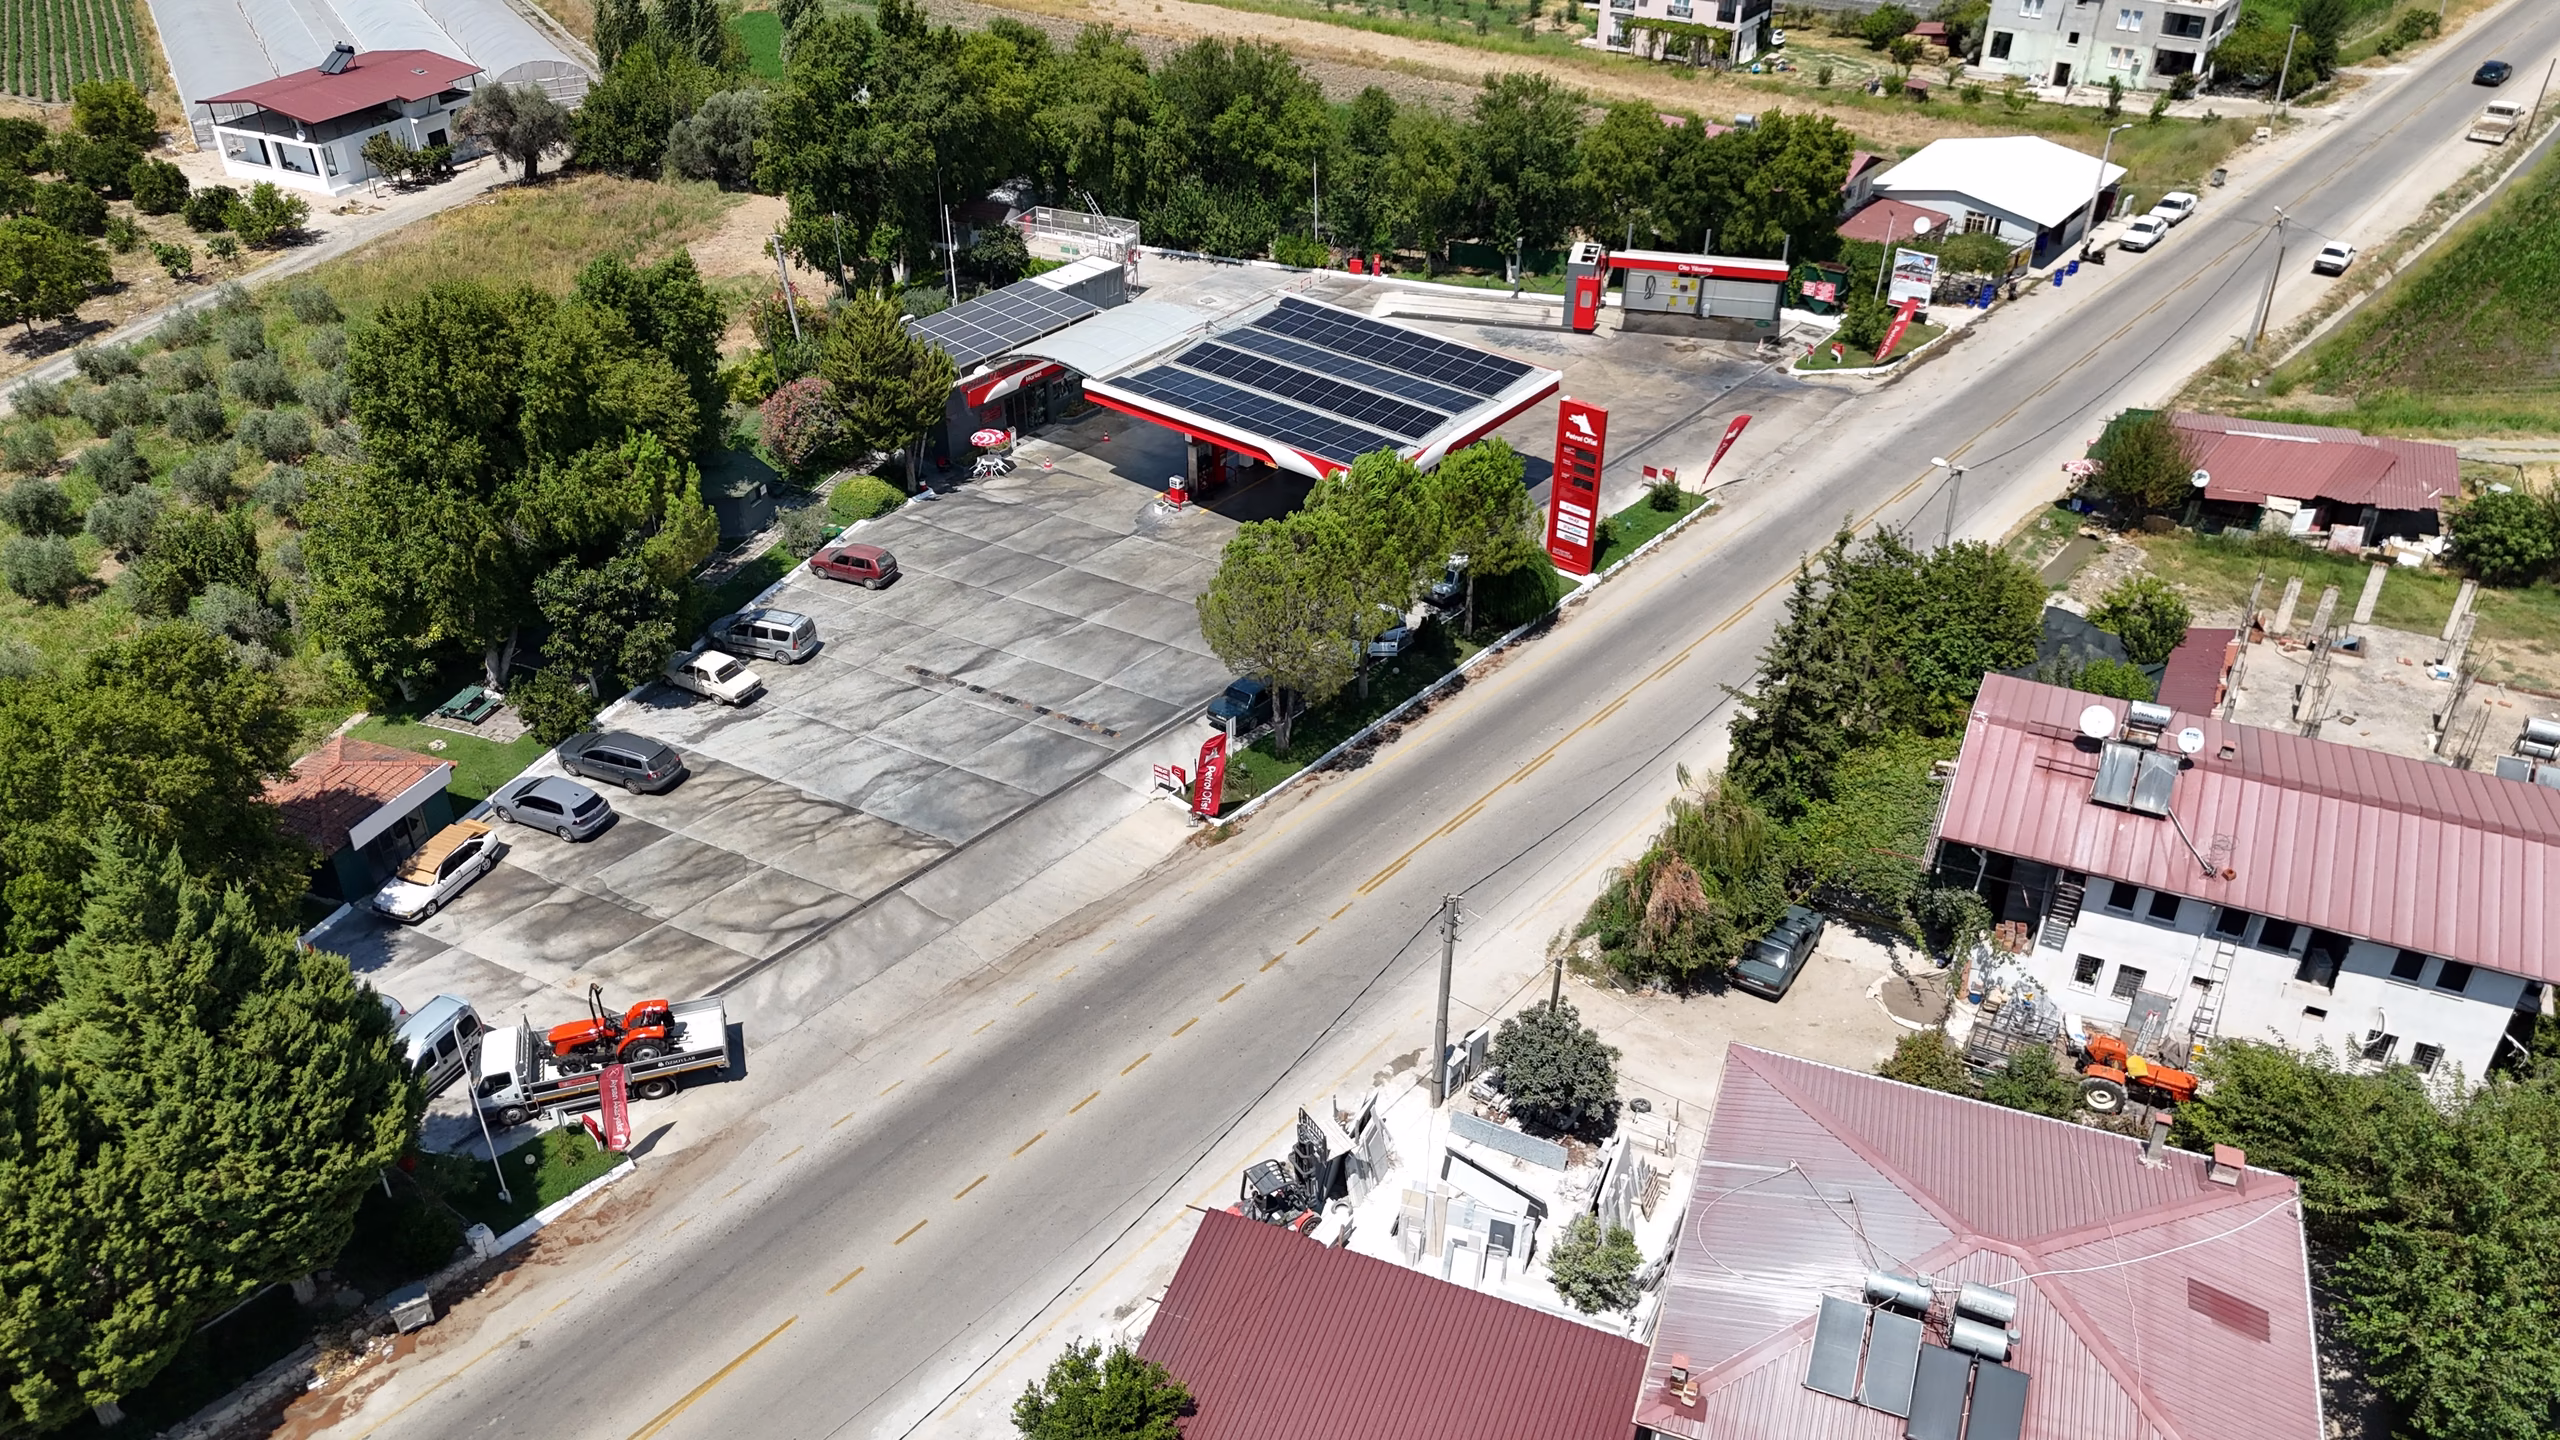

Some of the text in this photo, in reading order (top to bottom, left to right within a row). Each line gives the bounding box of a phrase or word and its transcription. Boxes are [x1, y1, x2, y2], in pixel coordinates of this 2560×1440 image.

[1565, 431, 1583, 443] Petrol
[1200, 765, 1216, 811] Petrol Ofisi
